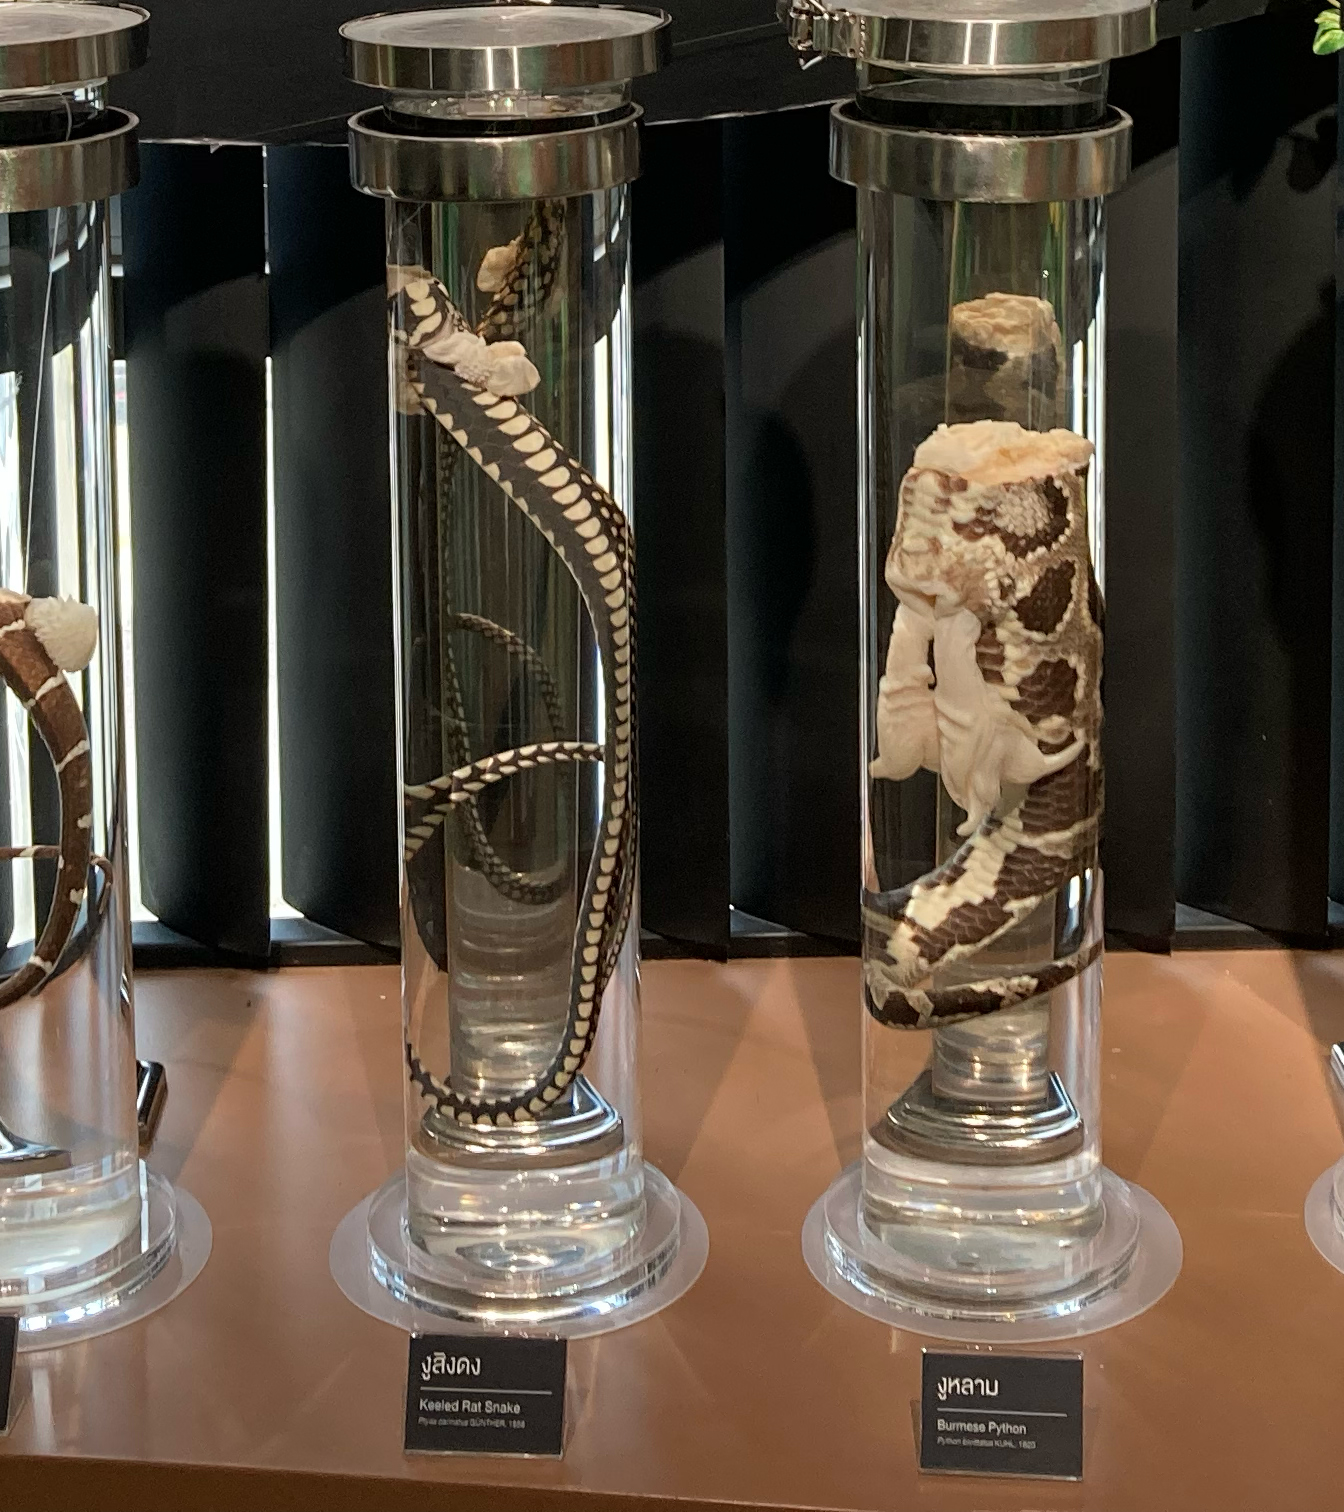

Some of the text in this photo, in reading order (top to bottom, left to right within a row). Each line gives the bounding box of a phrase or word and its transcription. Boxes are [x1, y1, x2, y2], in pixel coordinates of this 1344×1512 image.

[421, 1351, 481, 1381] งูสิงดง
[937, 1376, 999, 1400] งูหลาม
[419, 1398, 521, 1414] Keeled Rat Snake
[937, 1418, 1027, 1436] Burmese Python
